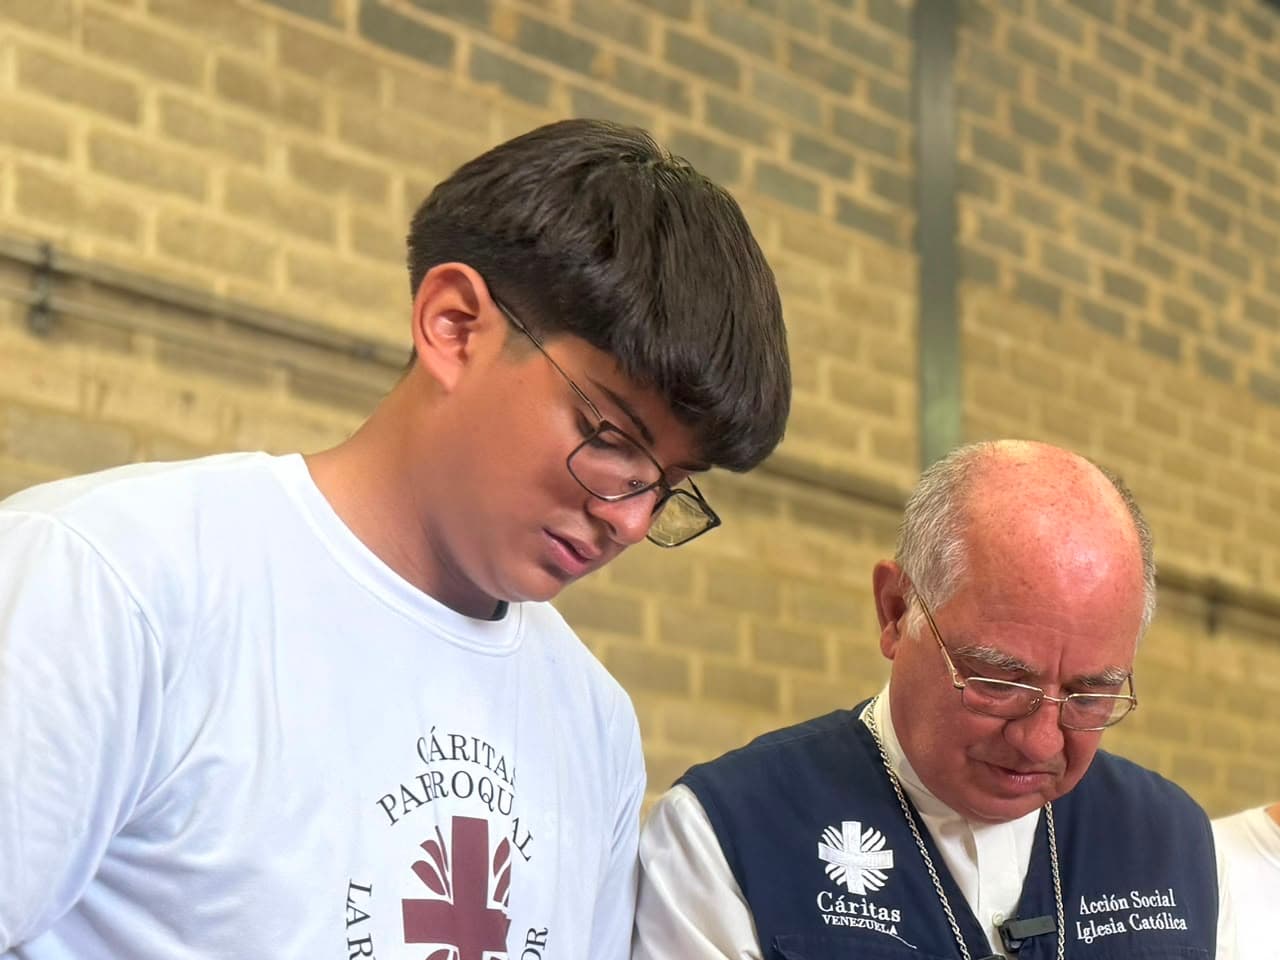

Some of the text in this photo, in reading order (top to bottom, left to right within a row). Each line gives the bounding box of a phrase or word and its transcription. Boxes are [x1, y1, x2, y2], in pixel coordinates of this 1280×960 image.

[346, 878, 373, 930] LA
[816, 890, 901, 923] Cáritas
[1079, 888, 1177, 916] Acción Social
[822, 914, 899, 936] VENEZUELA
[1076, 912, 1188, 944] Iglesia Católica
